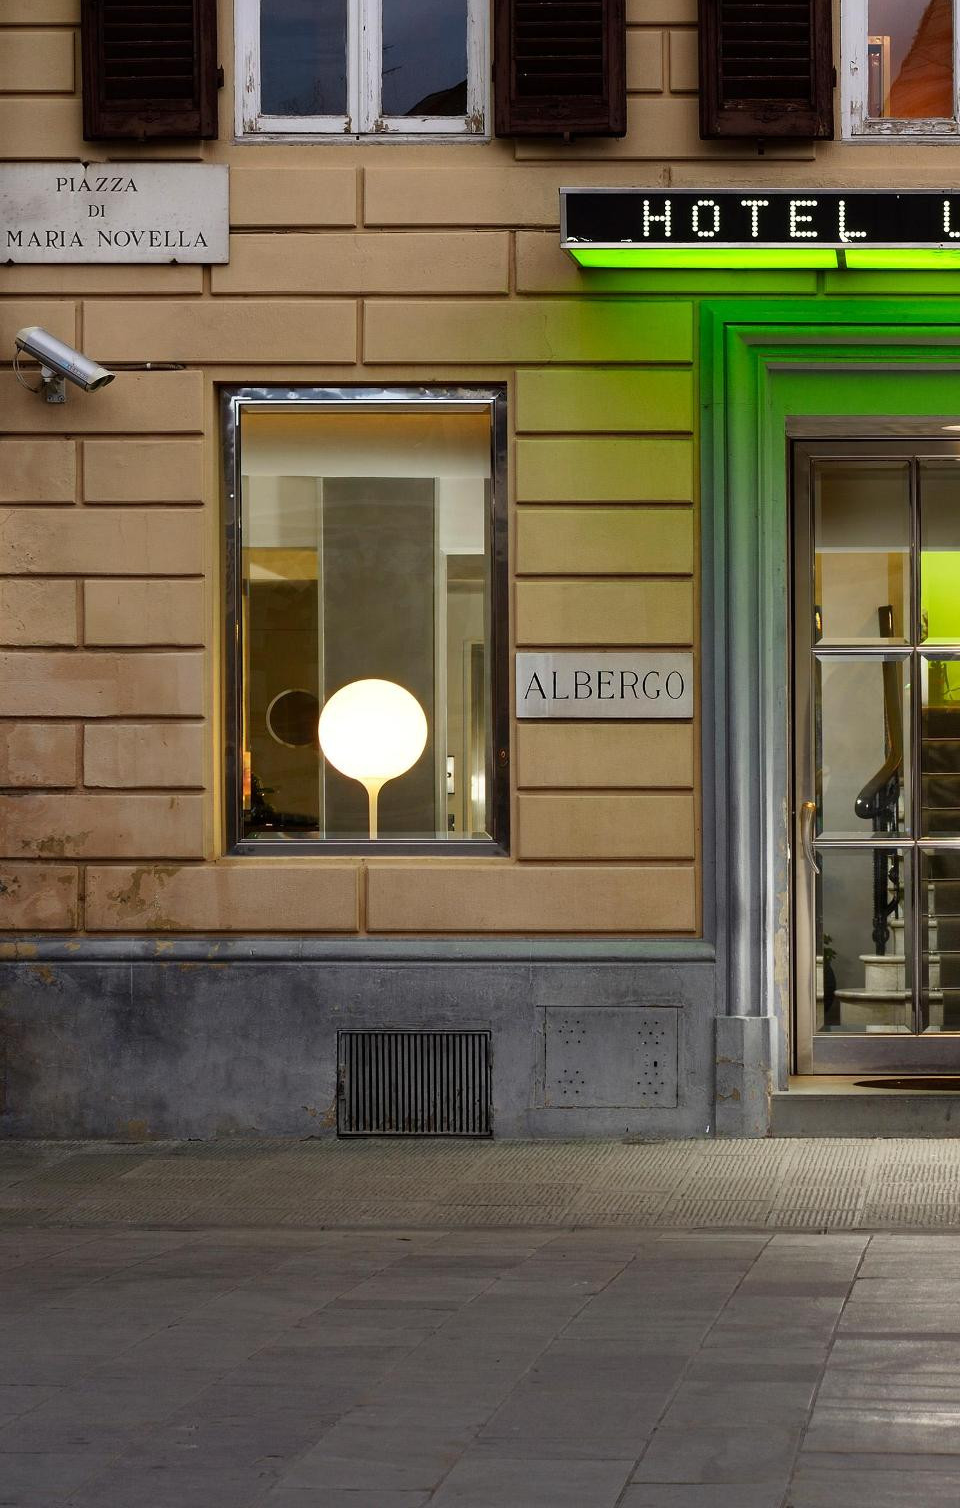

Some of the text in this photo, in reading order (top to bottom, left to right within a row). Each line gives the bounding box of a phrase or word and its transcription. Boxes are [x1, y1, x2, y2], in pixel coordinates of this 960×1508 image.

[56, 177, 138, 192] PIAZZA
[88, 204, 105, 218] DI
[643, 199, 869, 239] HOTEL
[6, 230, 209, 249] MARIA NOVELLA
[524, 670, 685, 700] ALBERGO
